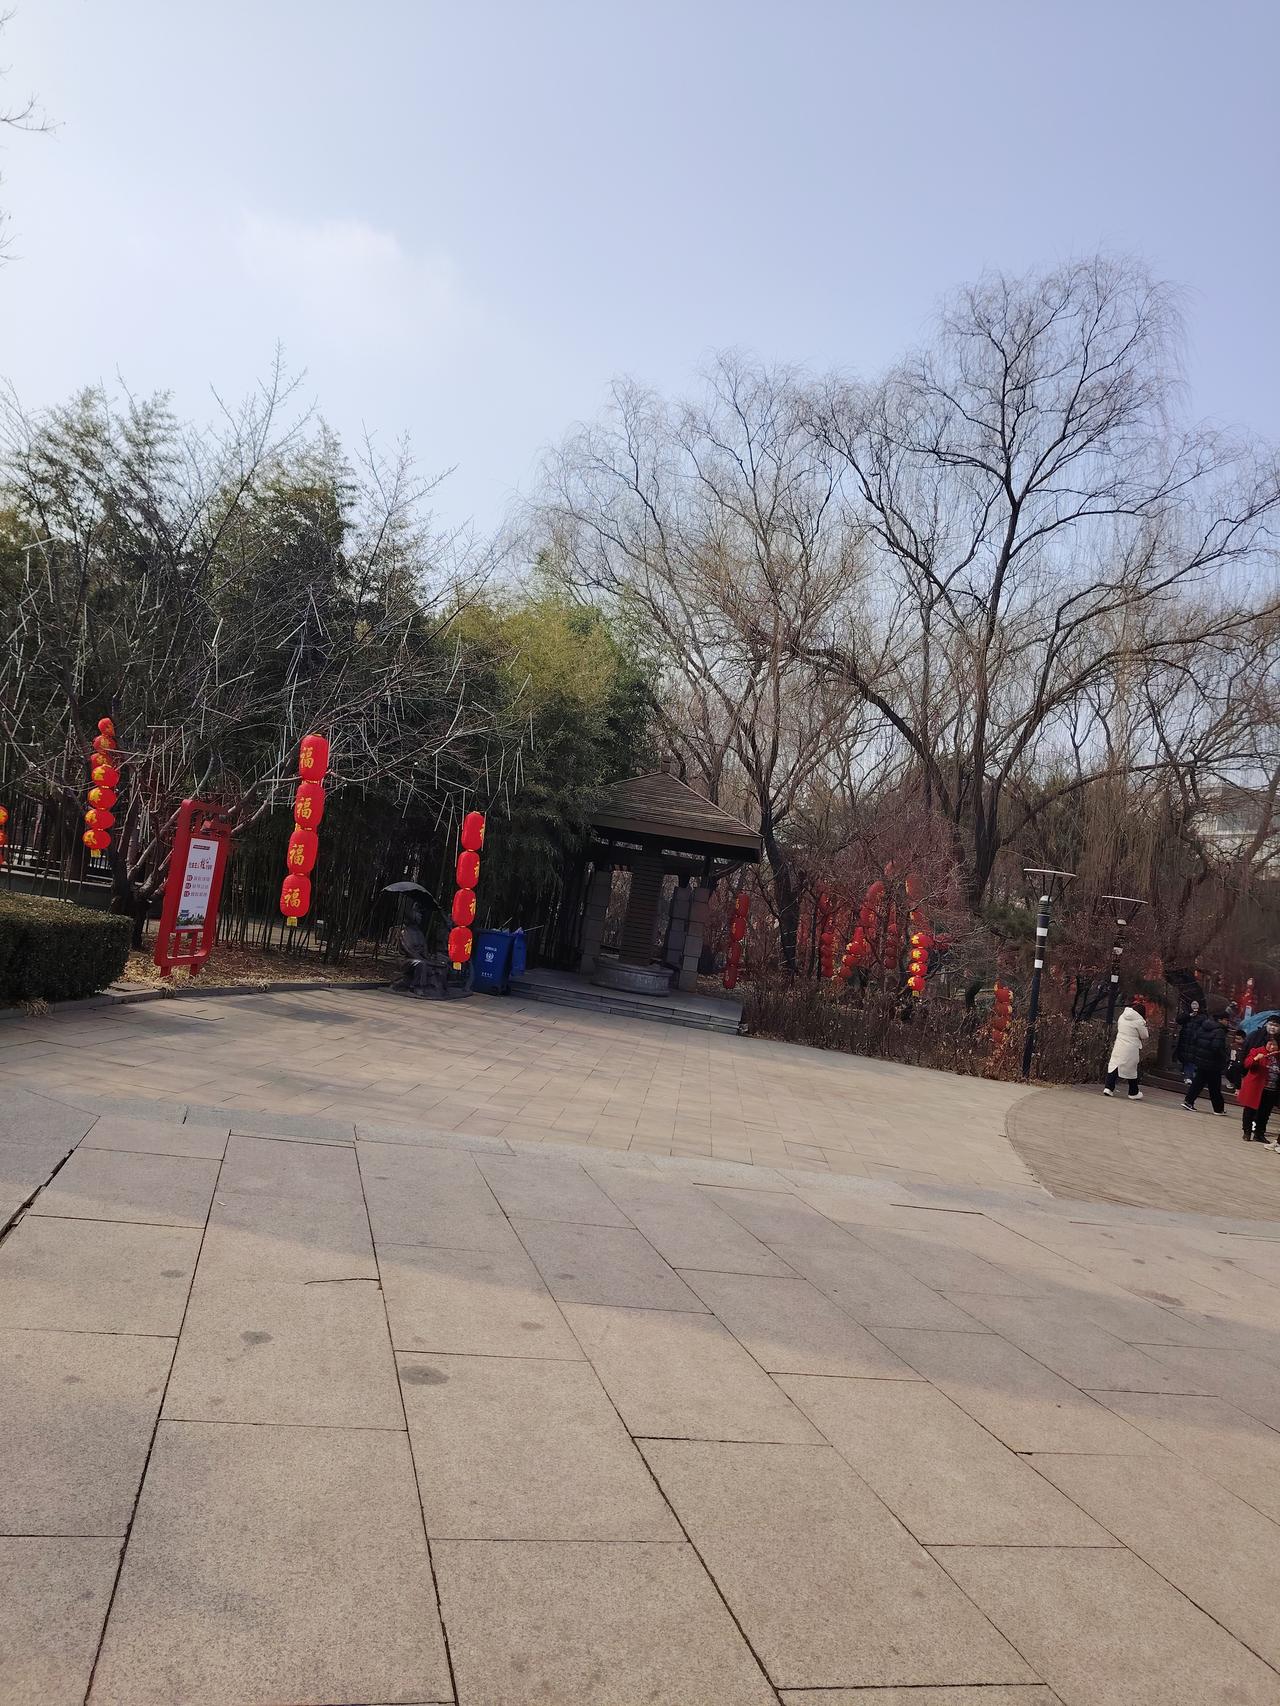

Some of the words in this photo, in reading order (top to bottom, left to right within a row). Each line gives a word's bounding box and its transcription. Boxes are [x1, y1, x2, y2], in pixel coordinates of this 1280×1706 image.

[300, 746, 314, 768] 福
[297, 797, 312, 819] 福
[289, 843, 304, 866] 福
[284, 887, 301, 908] 福
